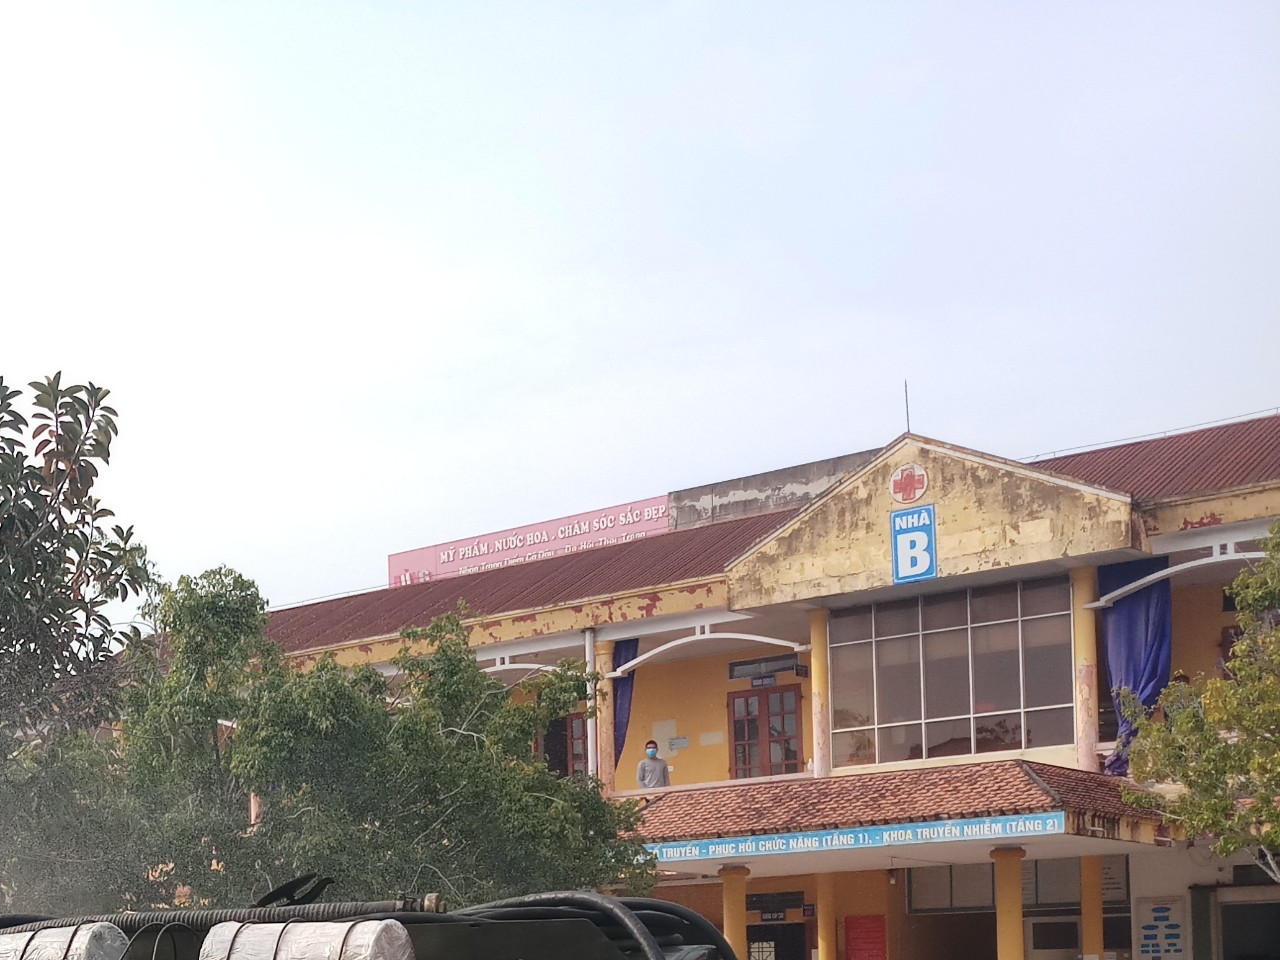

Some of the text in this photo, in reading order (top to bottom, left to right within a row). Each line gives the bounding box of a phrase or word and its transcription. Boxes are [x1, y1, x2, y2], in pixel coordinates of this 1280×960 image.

[526, 530, 549, 545] HOA
[592, 513, 615, 531] SÓC
[895, 510, 930, 531] NHÀ
[896, 531, 931, 578] B
[789, 836, 819, 849] NĂNG
[882, 829, 913, 842] KHOA
[1046, 818, 1058, 831] 2)
